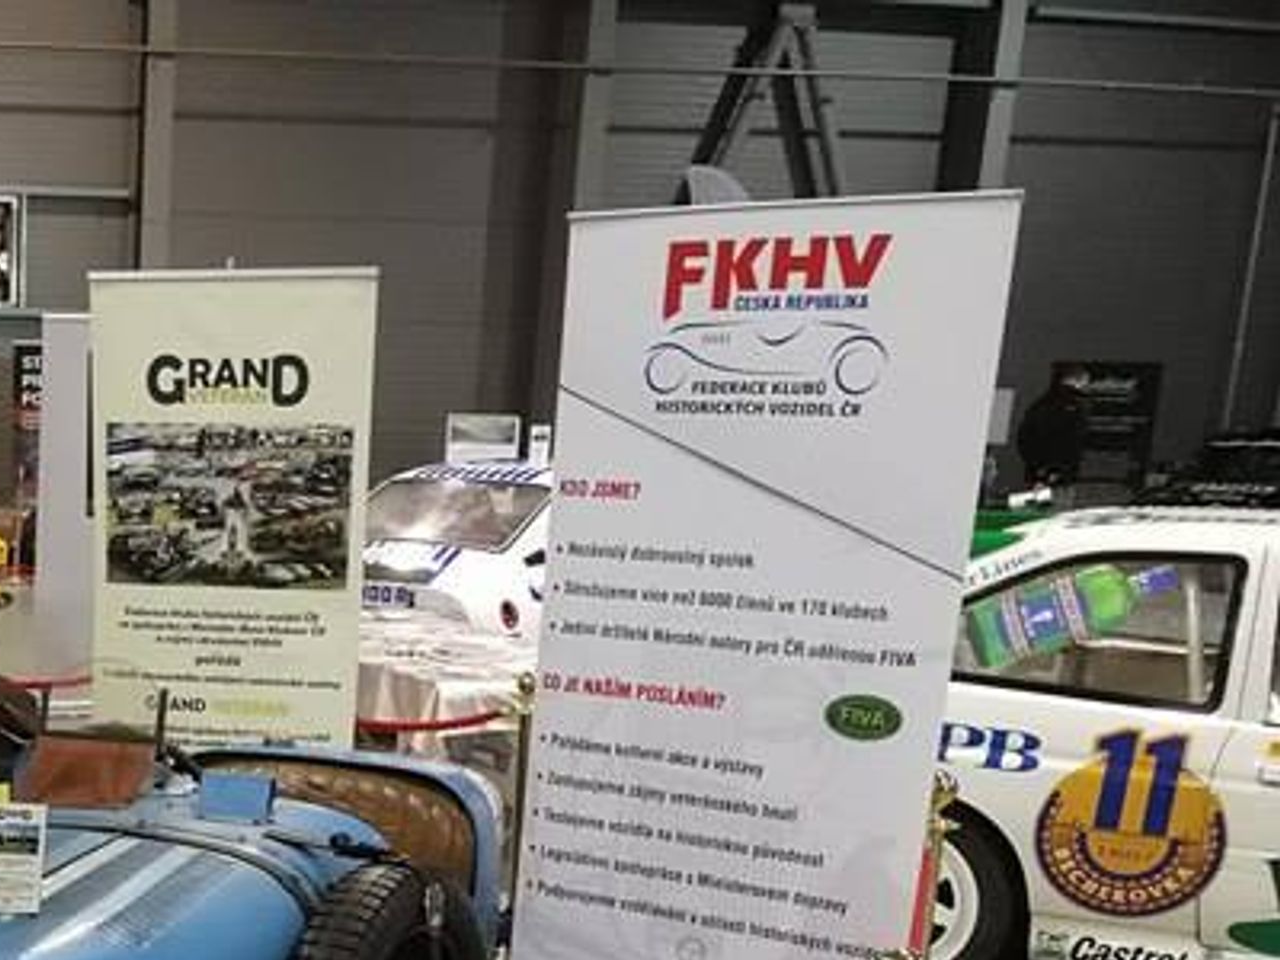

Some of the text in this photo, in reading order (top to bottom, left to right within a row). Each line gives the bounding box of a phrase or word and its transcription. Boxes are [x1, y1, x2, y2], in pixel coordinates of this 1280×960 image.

[663, 233, 892, 322] FKHV
[785, 294, 869, 310] REPUBLIKA
[147, 354, 309, 408] GRAND
[691, 380, 767, 396] FEDERACE
[770, 401, 835, 417] VOZIDEL
[561, 480, 641, 501] KDO JSME?
[879, 648, 917, 667] FIVA
[1094, 727, 1190, 838] 11
